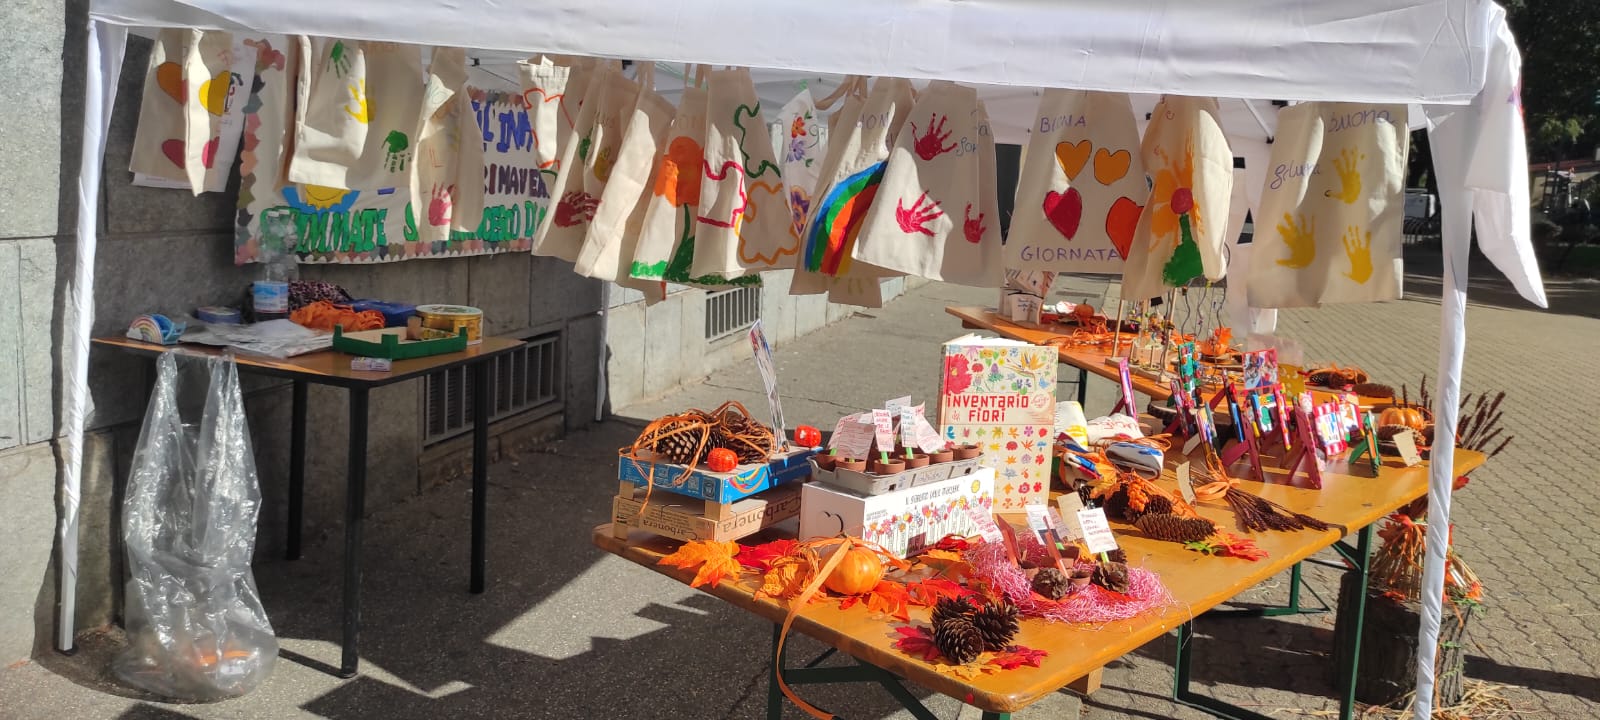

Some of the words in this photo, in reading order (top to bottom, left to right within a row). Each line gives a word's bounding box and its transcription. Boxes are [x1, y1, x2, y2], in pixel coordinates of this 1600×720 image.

[1021, 245, 1122, 262] GIORNATA
[722, 495, 801, 533] Carbonera
[642, 519, 698, 541] Carbonera
